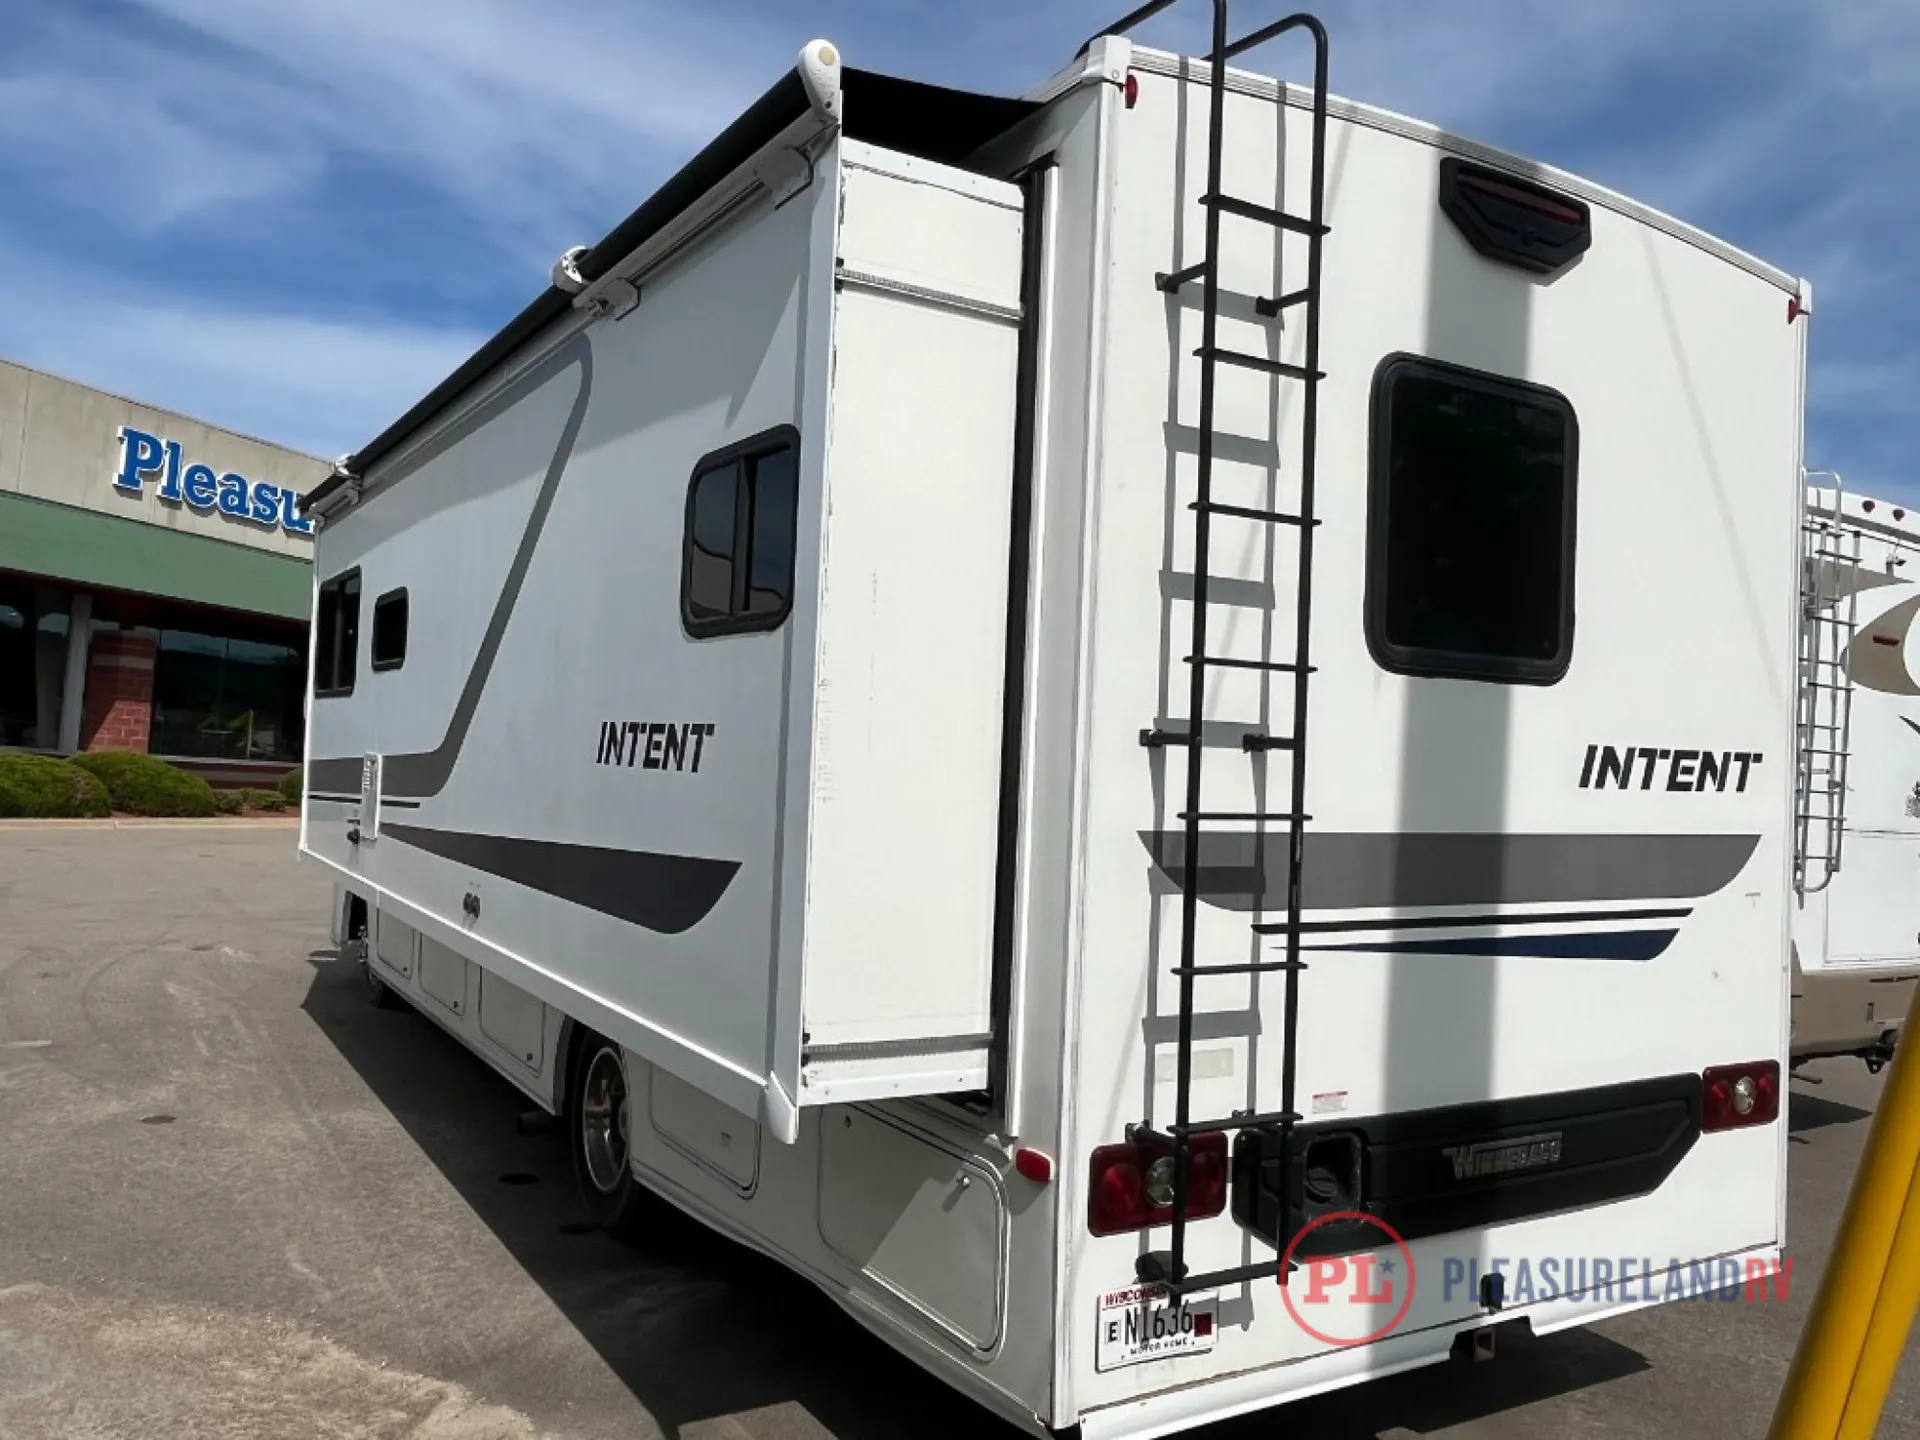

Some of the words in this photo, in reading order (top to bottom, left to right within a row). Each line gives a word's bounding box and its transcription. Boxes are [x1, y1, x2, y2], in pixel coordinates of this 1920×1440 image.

[595, 721, 715, 773] INTENT
[1578, 744, 1764, 793] INTENT
[1108, 1321, 1118, 1343] E
